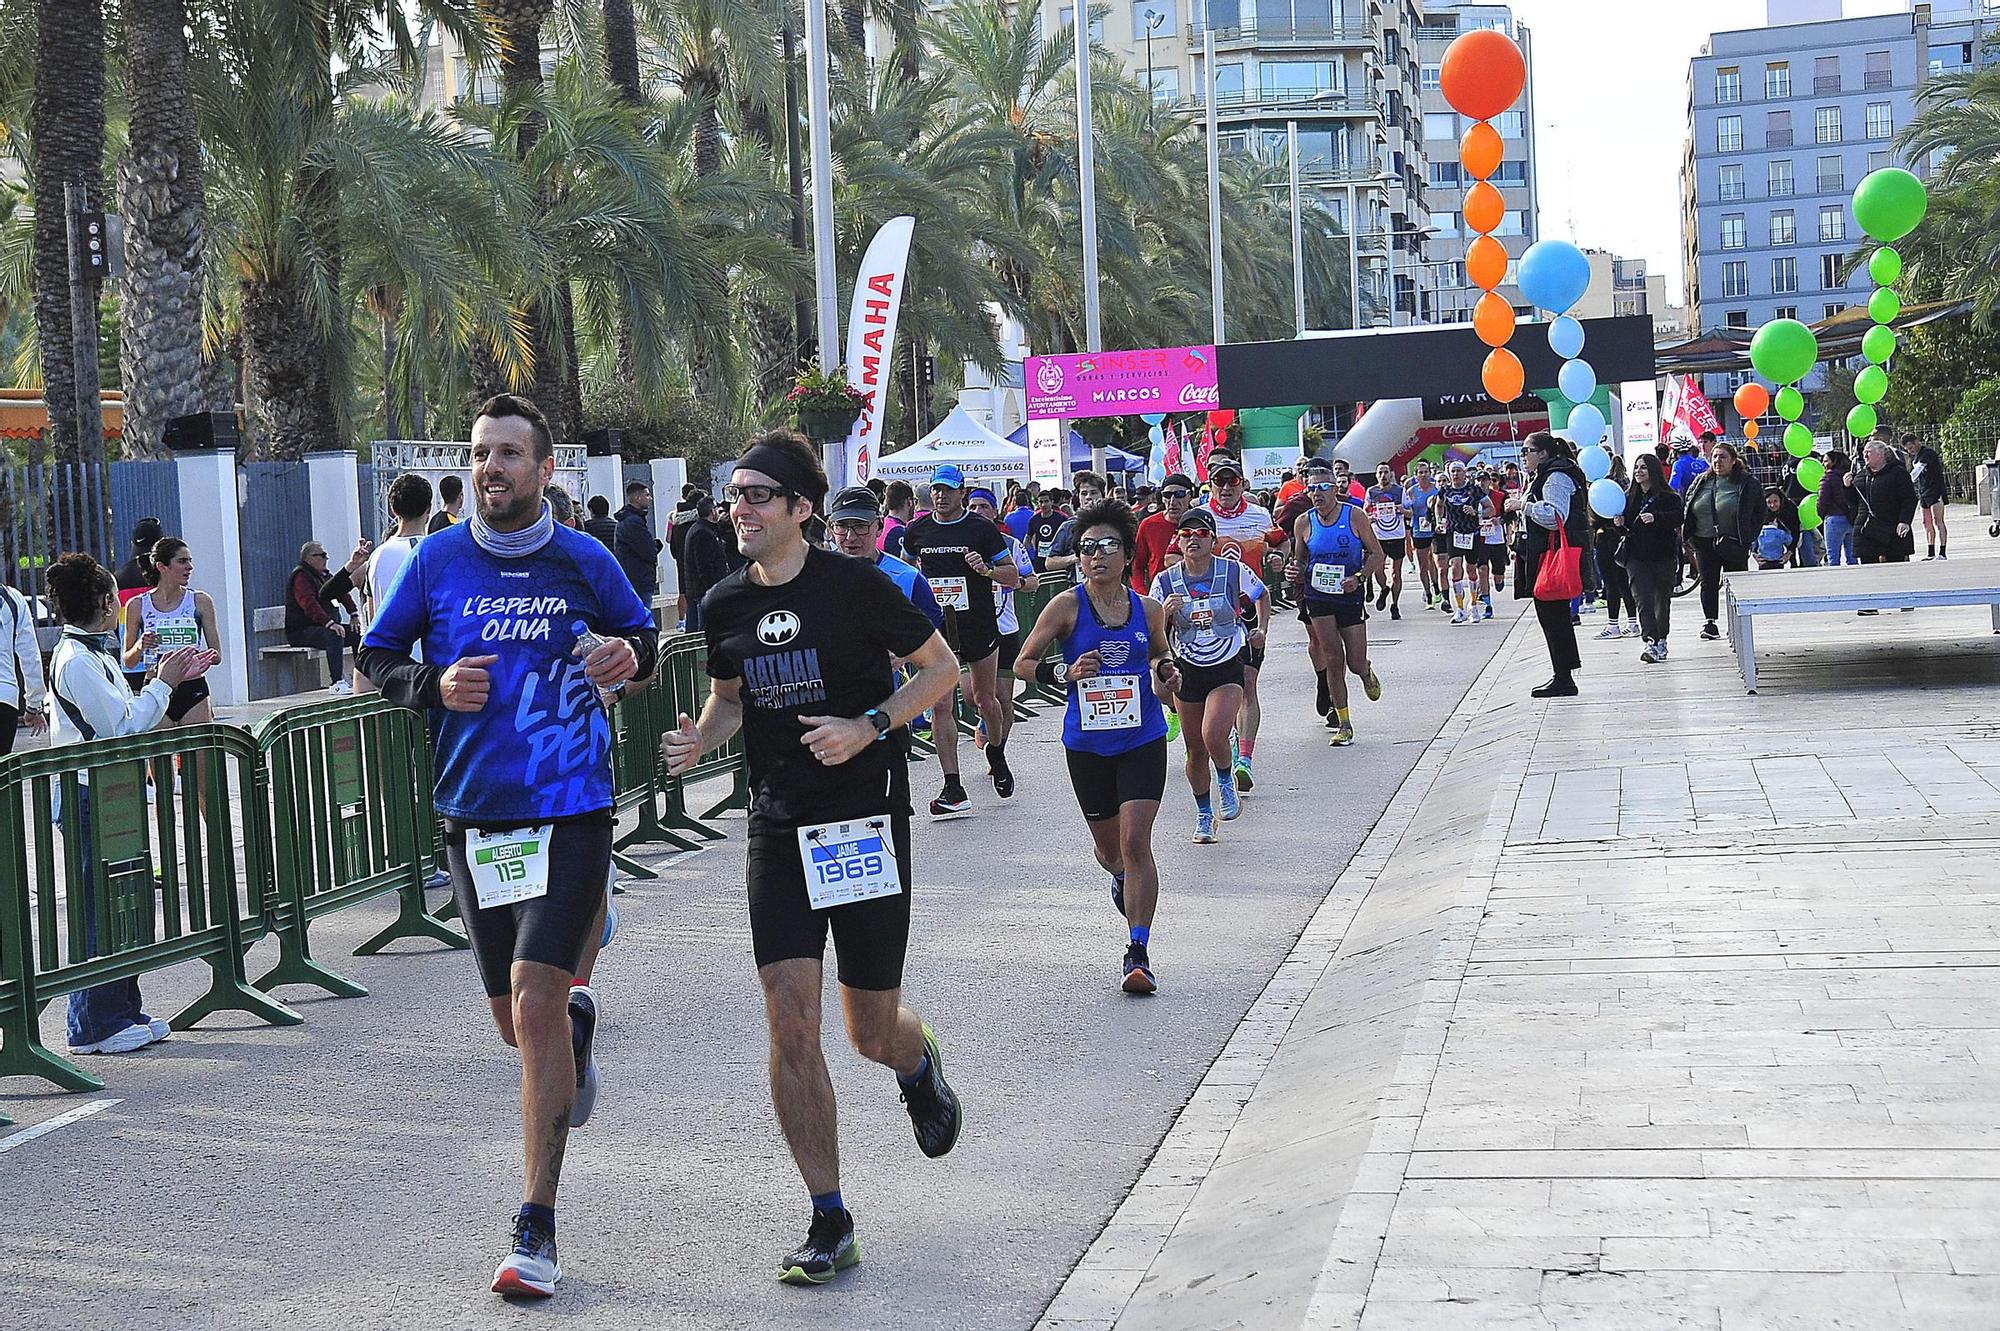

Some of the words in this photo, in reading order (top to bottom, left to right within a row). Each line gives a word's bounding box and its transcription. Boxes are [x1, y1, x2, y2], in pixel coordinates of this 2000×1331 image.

[860, 273, 895, 437] YAMAHA
[1120, 370, 1168, 379] SERVICIOS
[1092, 387, 1160, 402] MARCOS
[1028, 401, 1077, 409] AYUNTAMIENTO
[938, 439, 985, 447] EVENTOS
[973, 464, 989, 472] 615
[990, 463, 1001, 472] 30
[1002, 463, 1013, 471] 56
[1013, 462, 1025, 471] 62
[1319, 578, 1336, 586] 192
[462, 595, 568, 617] L'ESPENTA
[936, 593, 960, 603] 677
[481, 618, 552, 642] OLIVA
[162, 634, 192, 644] 5132
[743, 648, 821, 690] BATMAN
[514, 656, 597, 733] L'E
[1092, 700, 1128, 716] 1217
[492, 844, 522, 861] ALBERTO
[836, 842, 859, 858] JAIME
[495, 859, 526, 883] 113
[816, 855, 883, 884] 1969
